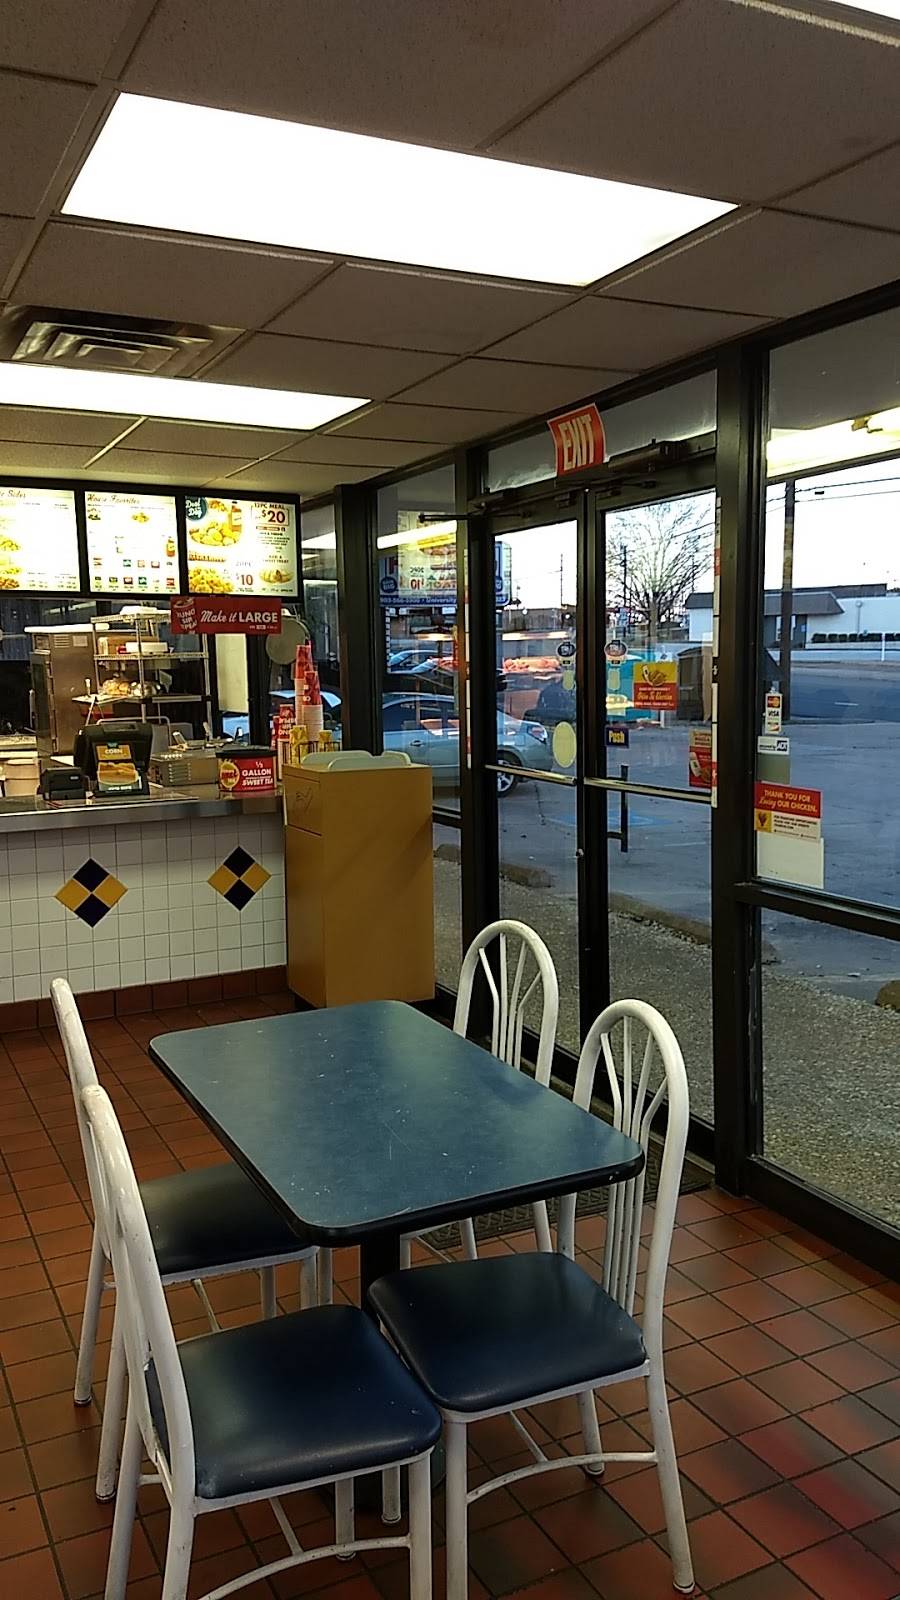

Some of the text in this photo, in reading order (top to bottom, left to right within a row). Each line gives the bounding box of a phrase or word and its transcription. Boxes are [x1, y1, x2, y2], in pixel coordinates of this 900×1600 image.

[558, 414, 594, 471] EXIT
[262, 509, 286, 523] $20
[200, 610, 227, 623] Make
[228, 611, 237, 623] it
[239, 612, 278, 623] LARGE
[609, 730, 625, 743] Push
[242, 778, 264, 786] SWEET
[764, 790, 811, 802] THANK YOU FOR
[777, 800, 790, 808] OUR
